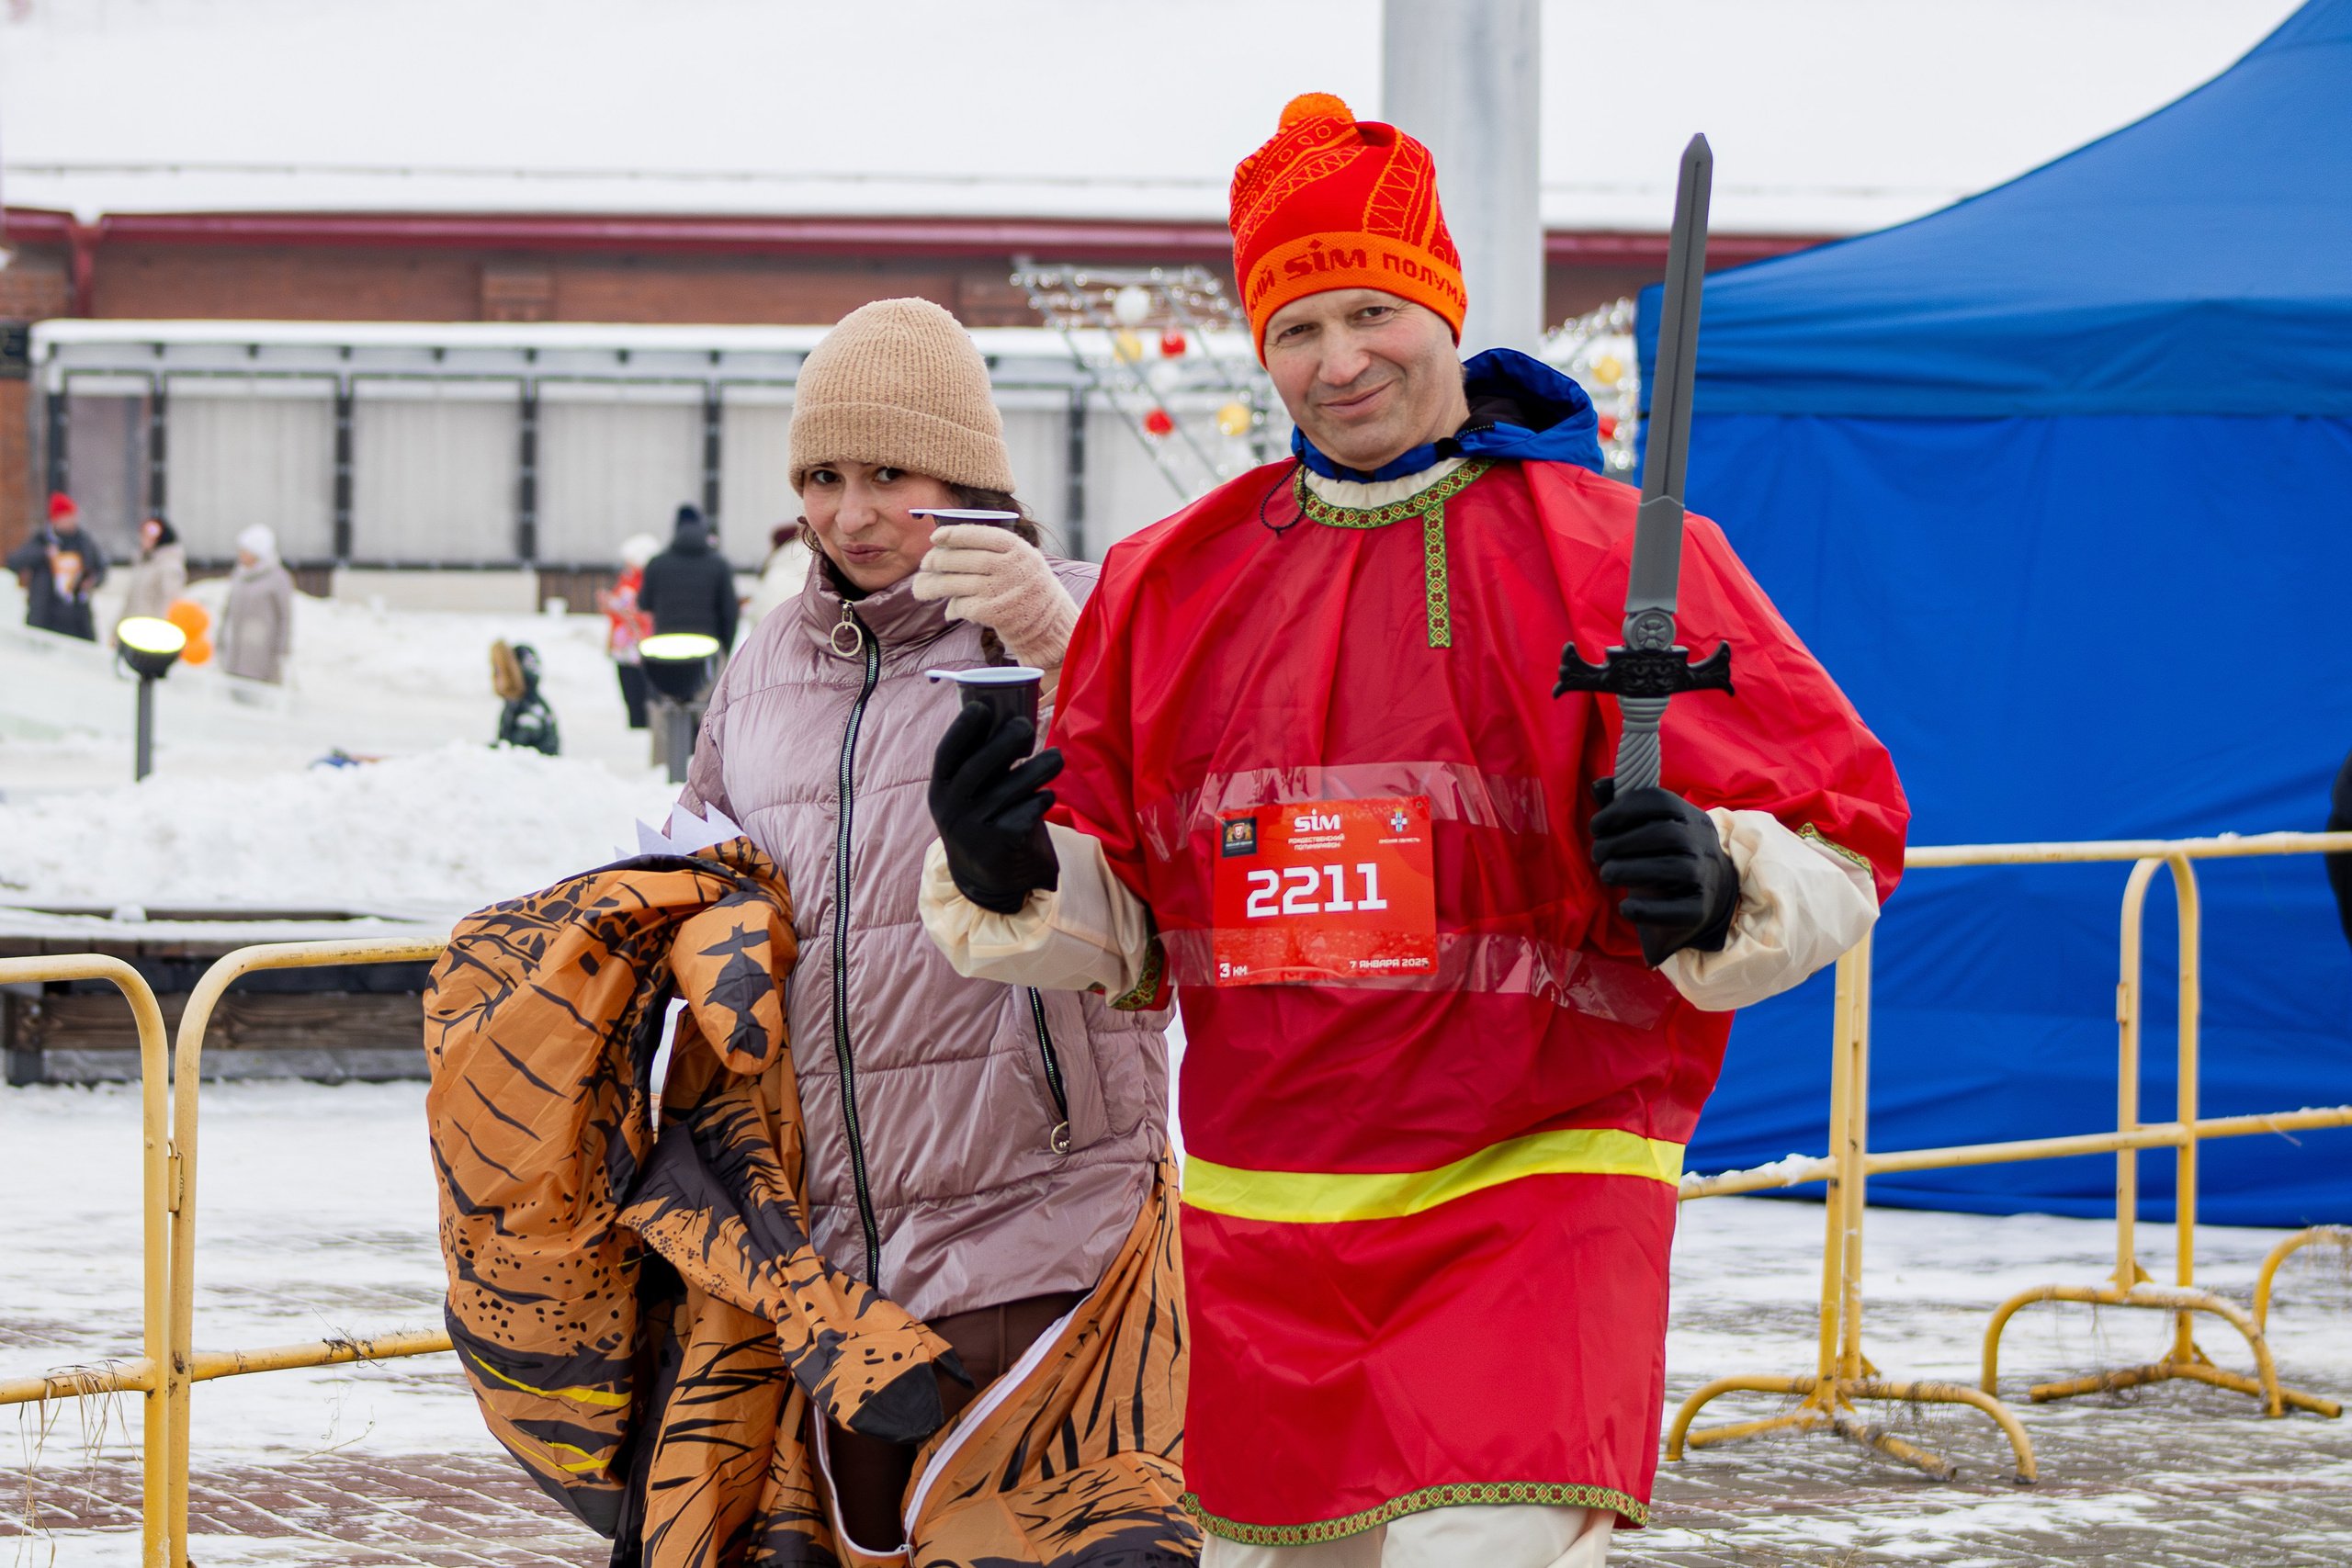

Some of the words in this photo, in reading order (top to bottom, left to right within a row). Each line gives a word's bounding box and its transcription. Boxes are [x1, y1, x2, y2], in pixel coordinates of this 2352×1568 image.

[1247, 863, 1387, 918] 2211
[1219, 963, 1230, 978] 3
[1349, 960, 1357, 969] 7
[1360, 958, 1400, 969] ЯНВАРЯ
[1401, 957, 1429, 967] 2025
